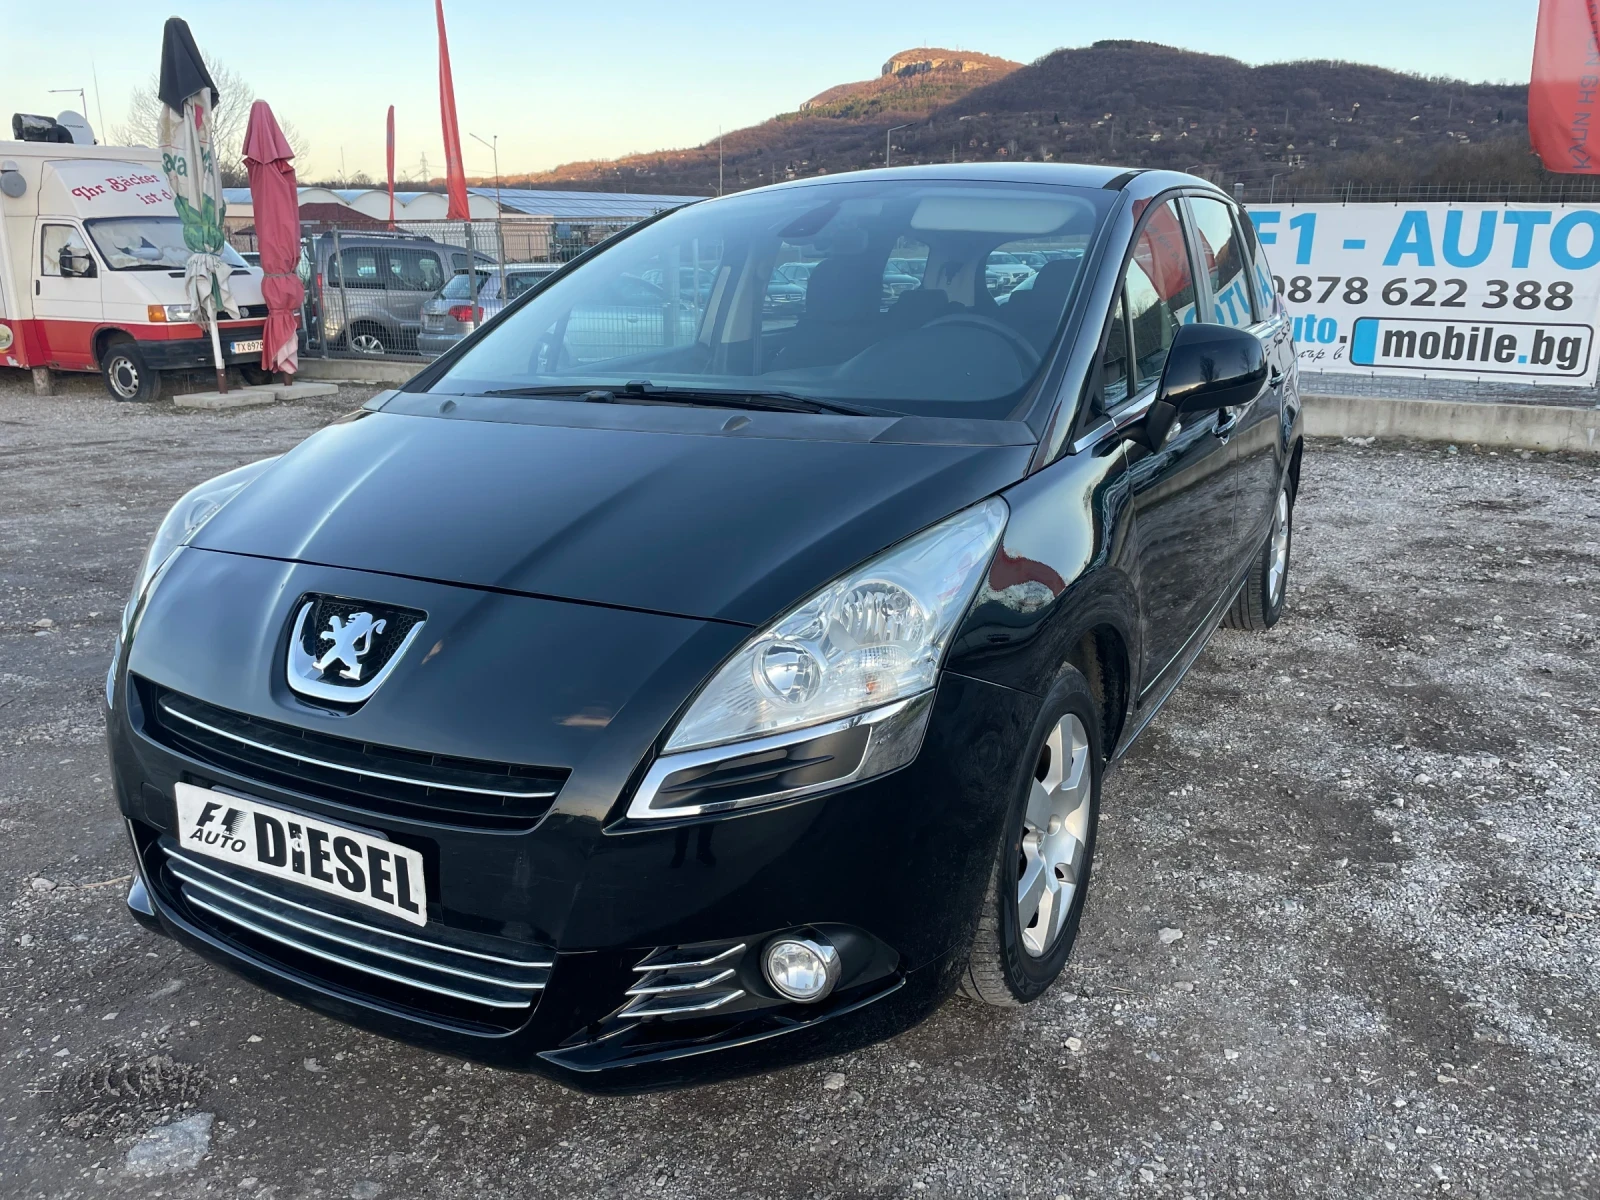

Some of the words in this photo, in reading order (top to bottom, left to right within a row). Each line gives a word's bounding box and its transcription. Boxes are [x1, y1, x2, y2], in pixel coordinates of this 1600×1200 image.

[105, 173, 161, 192] Bäcker
[136, 192, 162, 205] ist
[1382, 209, 1600, 270] AUTO
[1381, 277, 1468, 308] 622
[1482, 279, 1574, 311] 388
[1381, 326, 1582, 371] mobile.bg
[189, 827, 247, 853] AUTO
[253, 811, 419, 915] DIESEL
